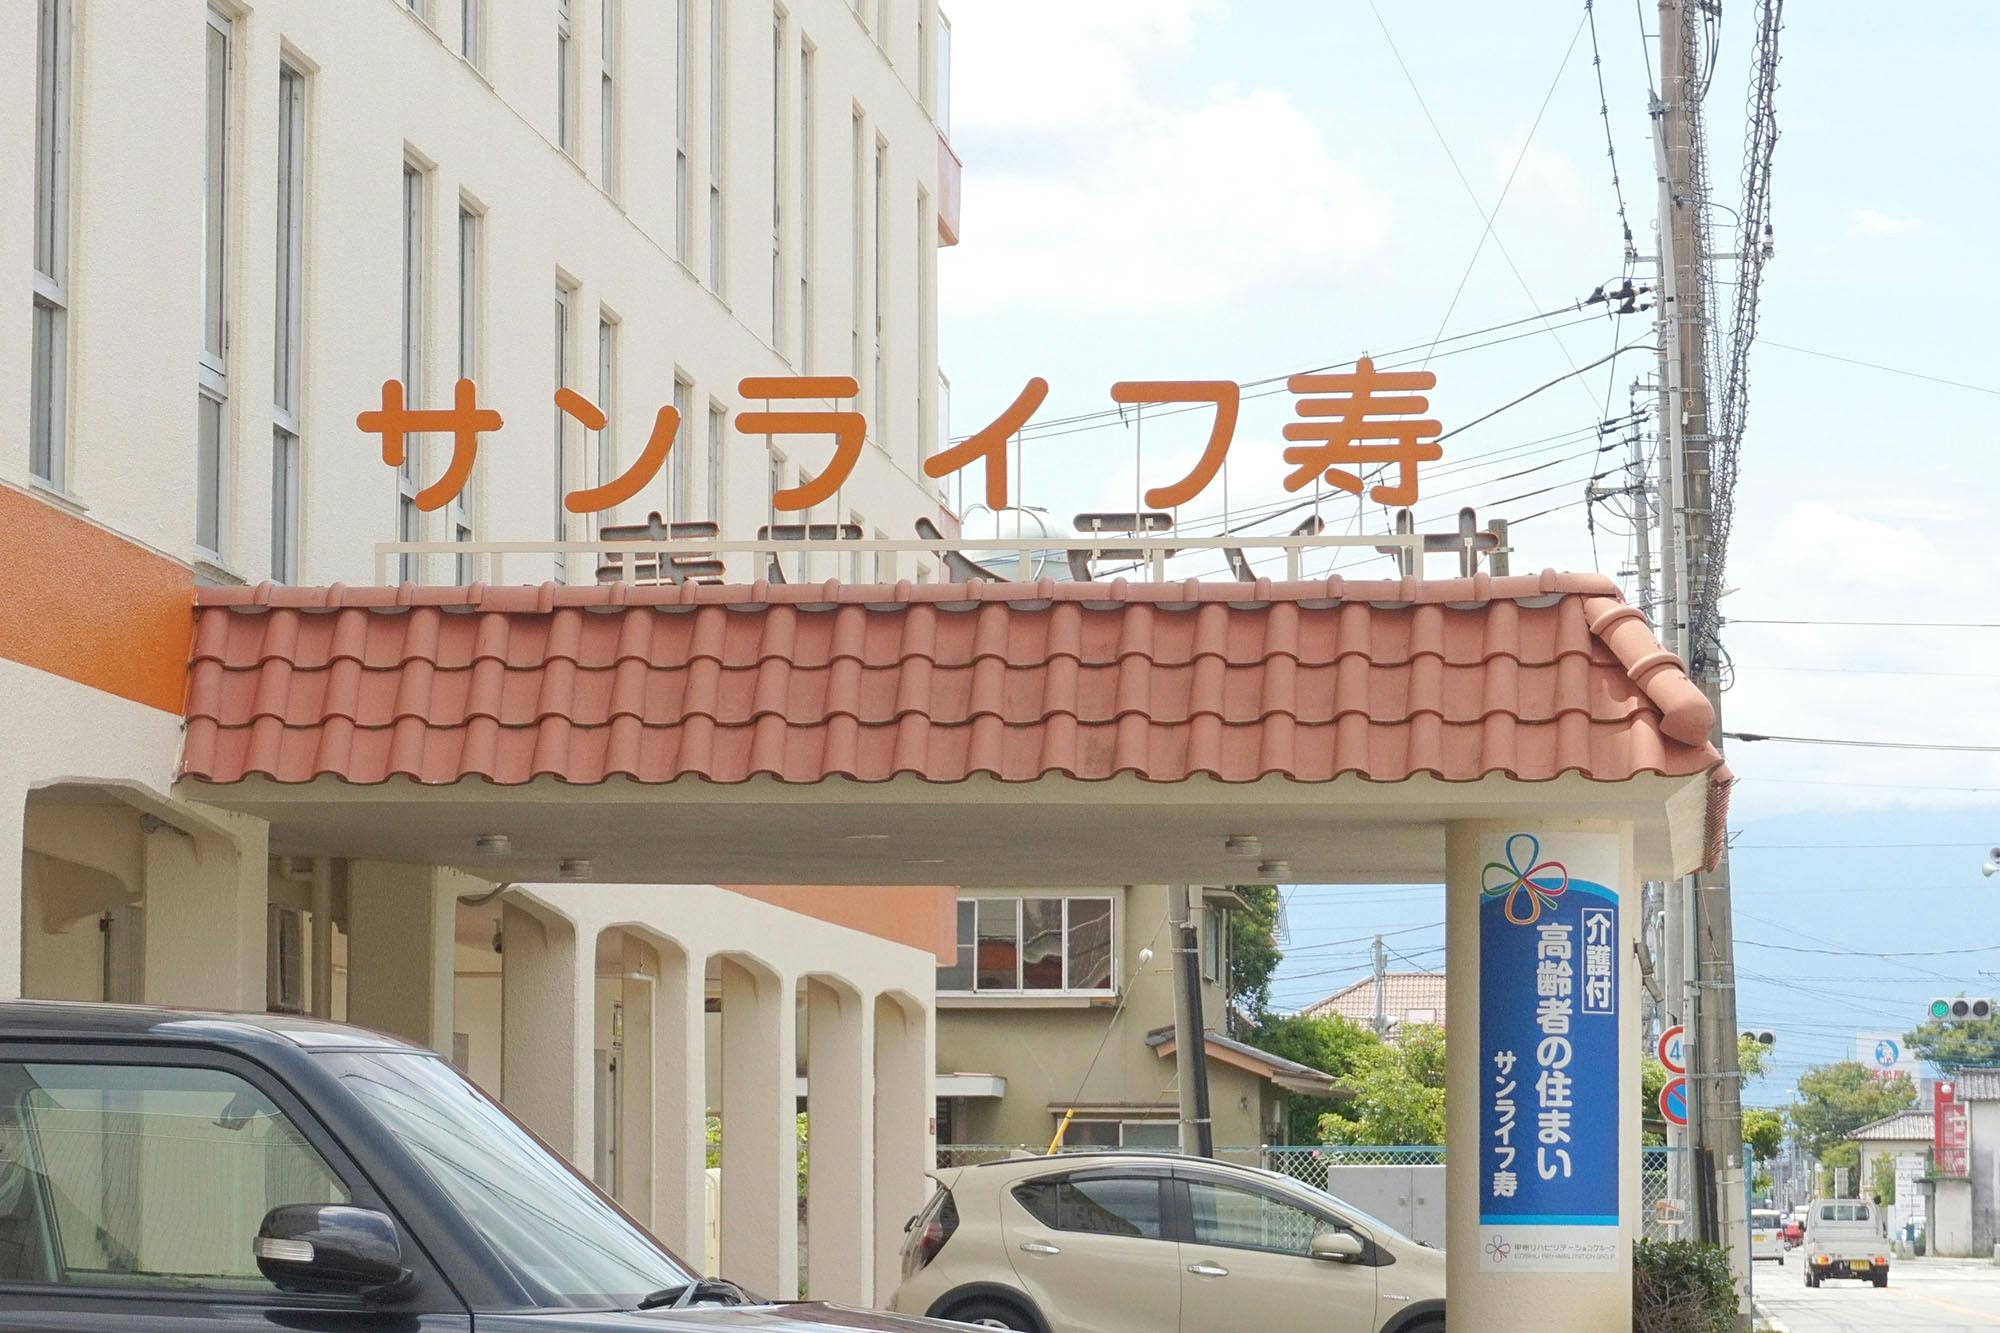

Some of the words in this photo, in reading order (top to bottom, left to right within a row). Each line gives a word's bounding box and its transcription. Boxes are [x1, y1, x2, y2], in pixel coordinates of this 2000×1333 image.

[356, 357, 1443, 512] サンライフ寿
[1586, 914, 1611, 1009] 介護付
[1493, 1051, 1517, 1197] サンライフ寿
[1536, 923, 1573, 1181] 高齢者の住まい
